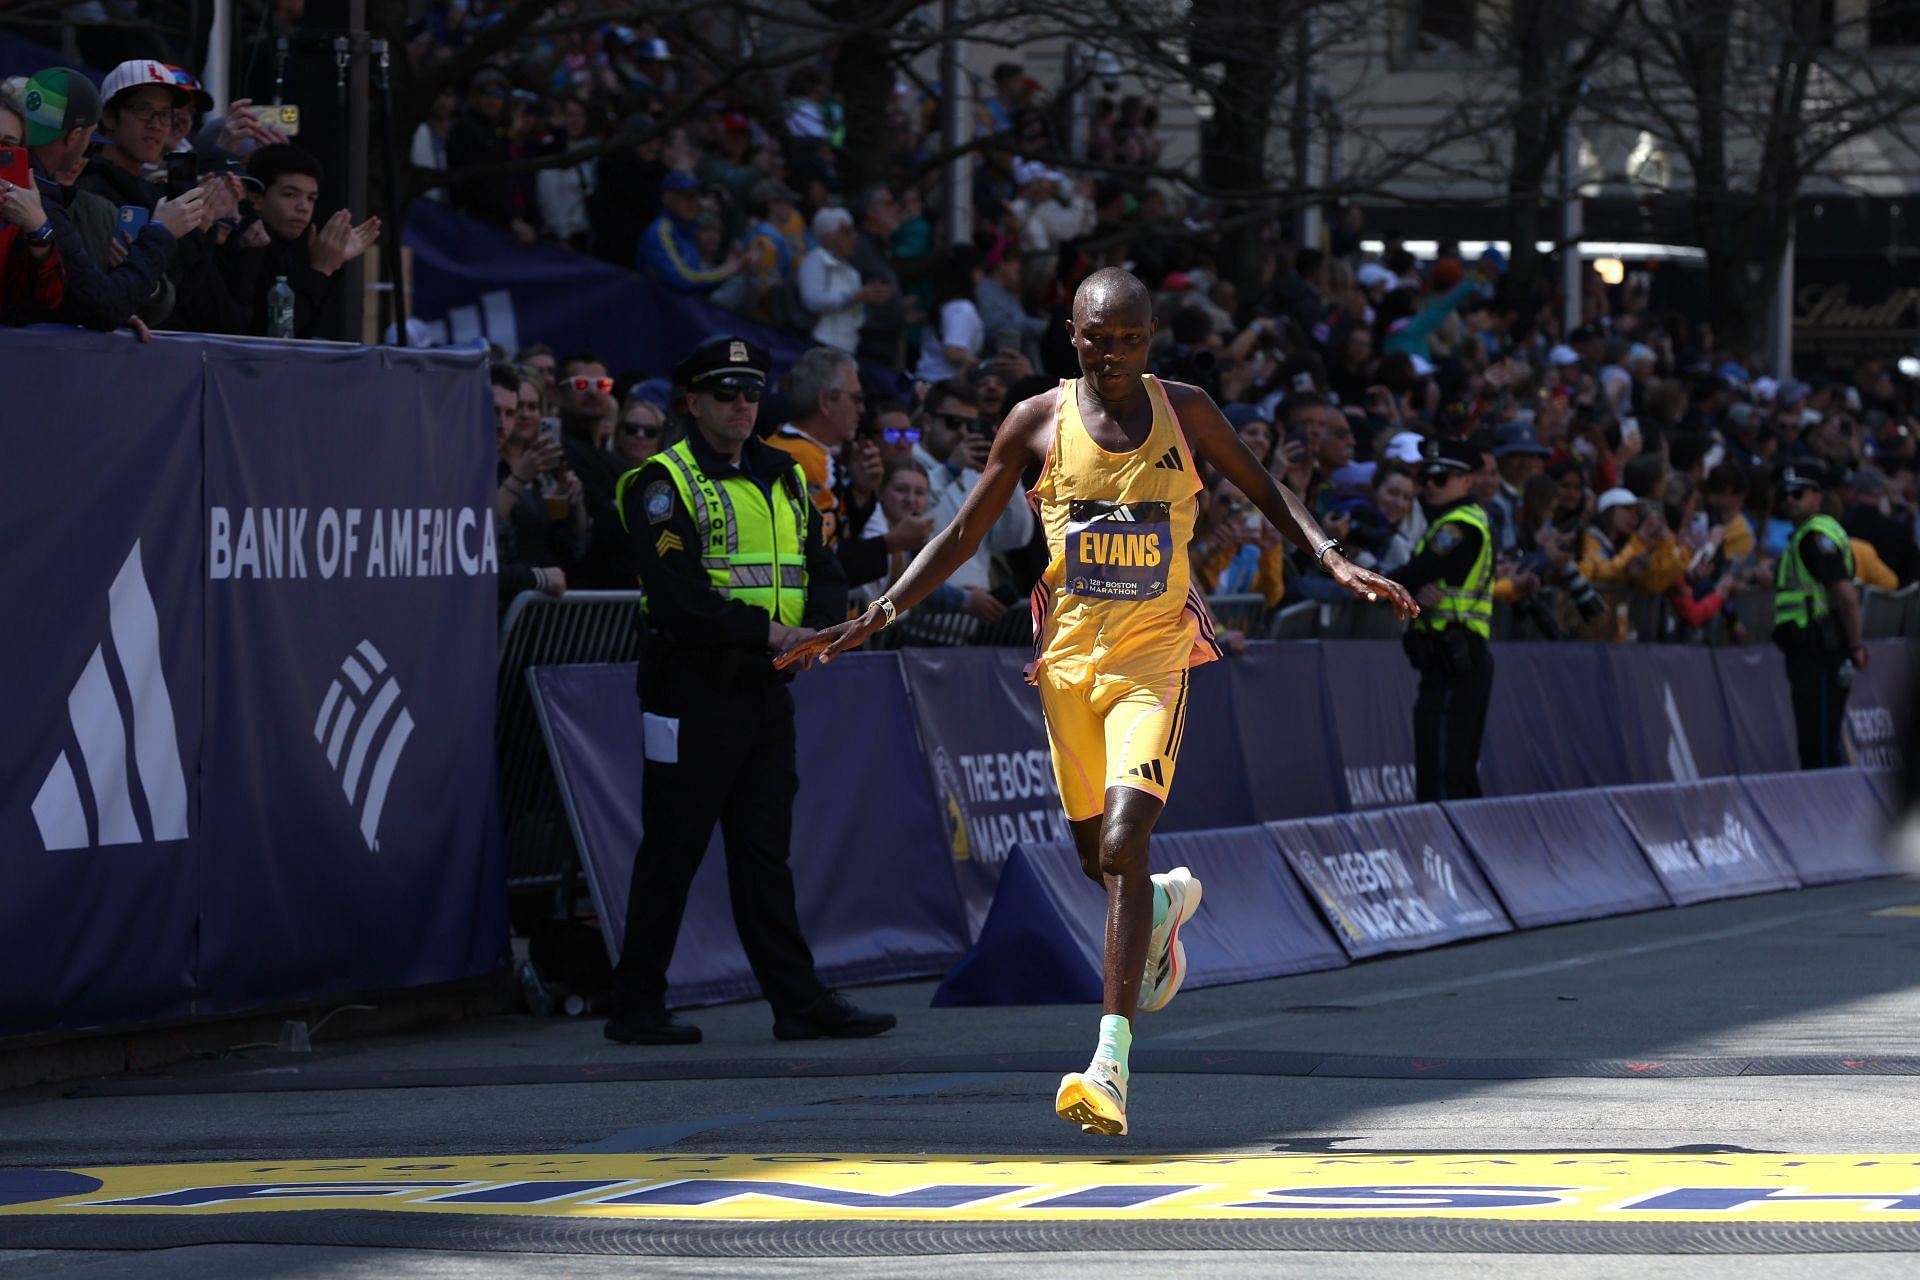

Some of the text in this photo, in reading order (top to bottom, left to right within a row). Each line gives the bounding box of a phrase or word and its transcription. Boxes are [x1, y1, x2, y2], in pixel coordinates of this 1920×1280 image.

[209, 506, 499, 579] BANK OF AMERICA
[1079, 532, 1161, 568] EVANS
[1089, 578, 1137, 589] 128 BOSTON
[1089, 585, 1137, 596] MARATHON
[960, 753, 1000, 802] THE
[646, 1155, 1240, 1166] BOSTON
[60, 1178, 1920, 1210] FINISH
